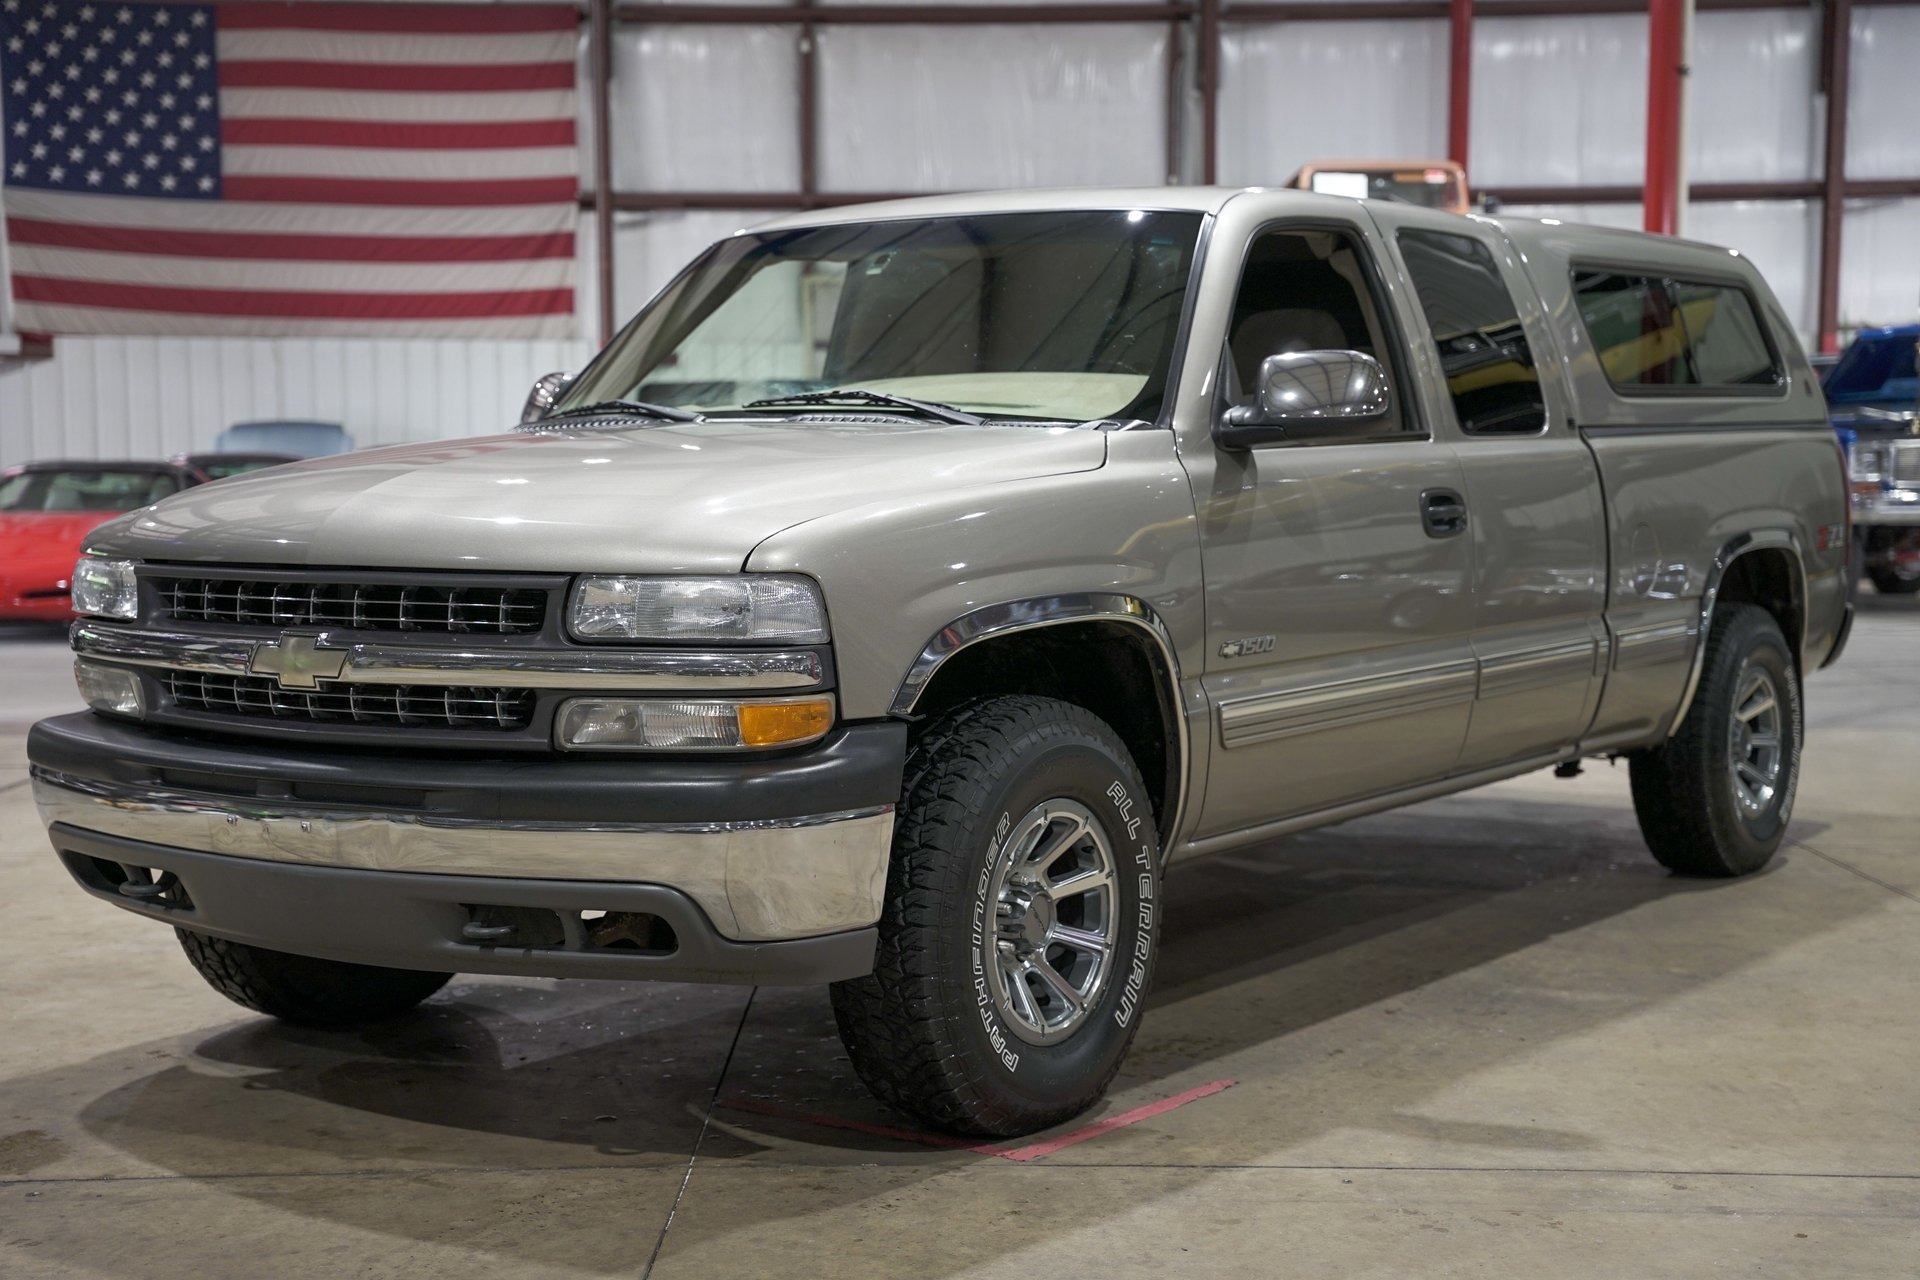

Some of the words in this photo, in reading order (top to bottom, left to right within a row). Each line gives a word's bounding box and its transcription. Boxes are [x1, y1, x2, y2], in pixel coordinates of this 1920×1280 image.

[1240, 634, 1277, 656] 1500
[1106, 780, 1142, 841] ALL
[970, 811, 1019, 1073] PATHFINDER
[1114, 845, 1153, 1029] TERRAIN
